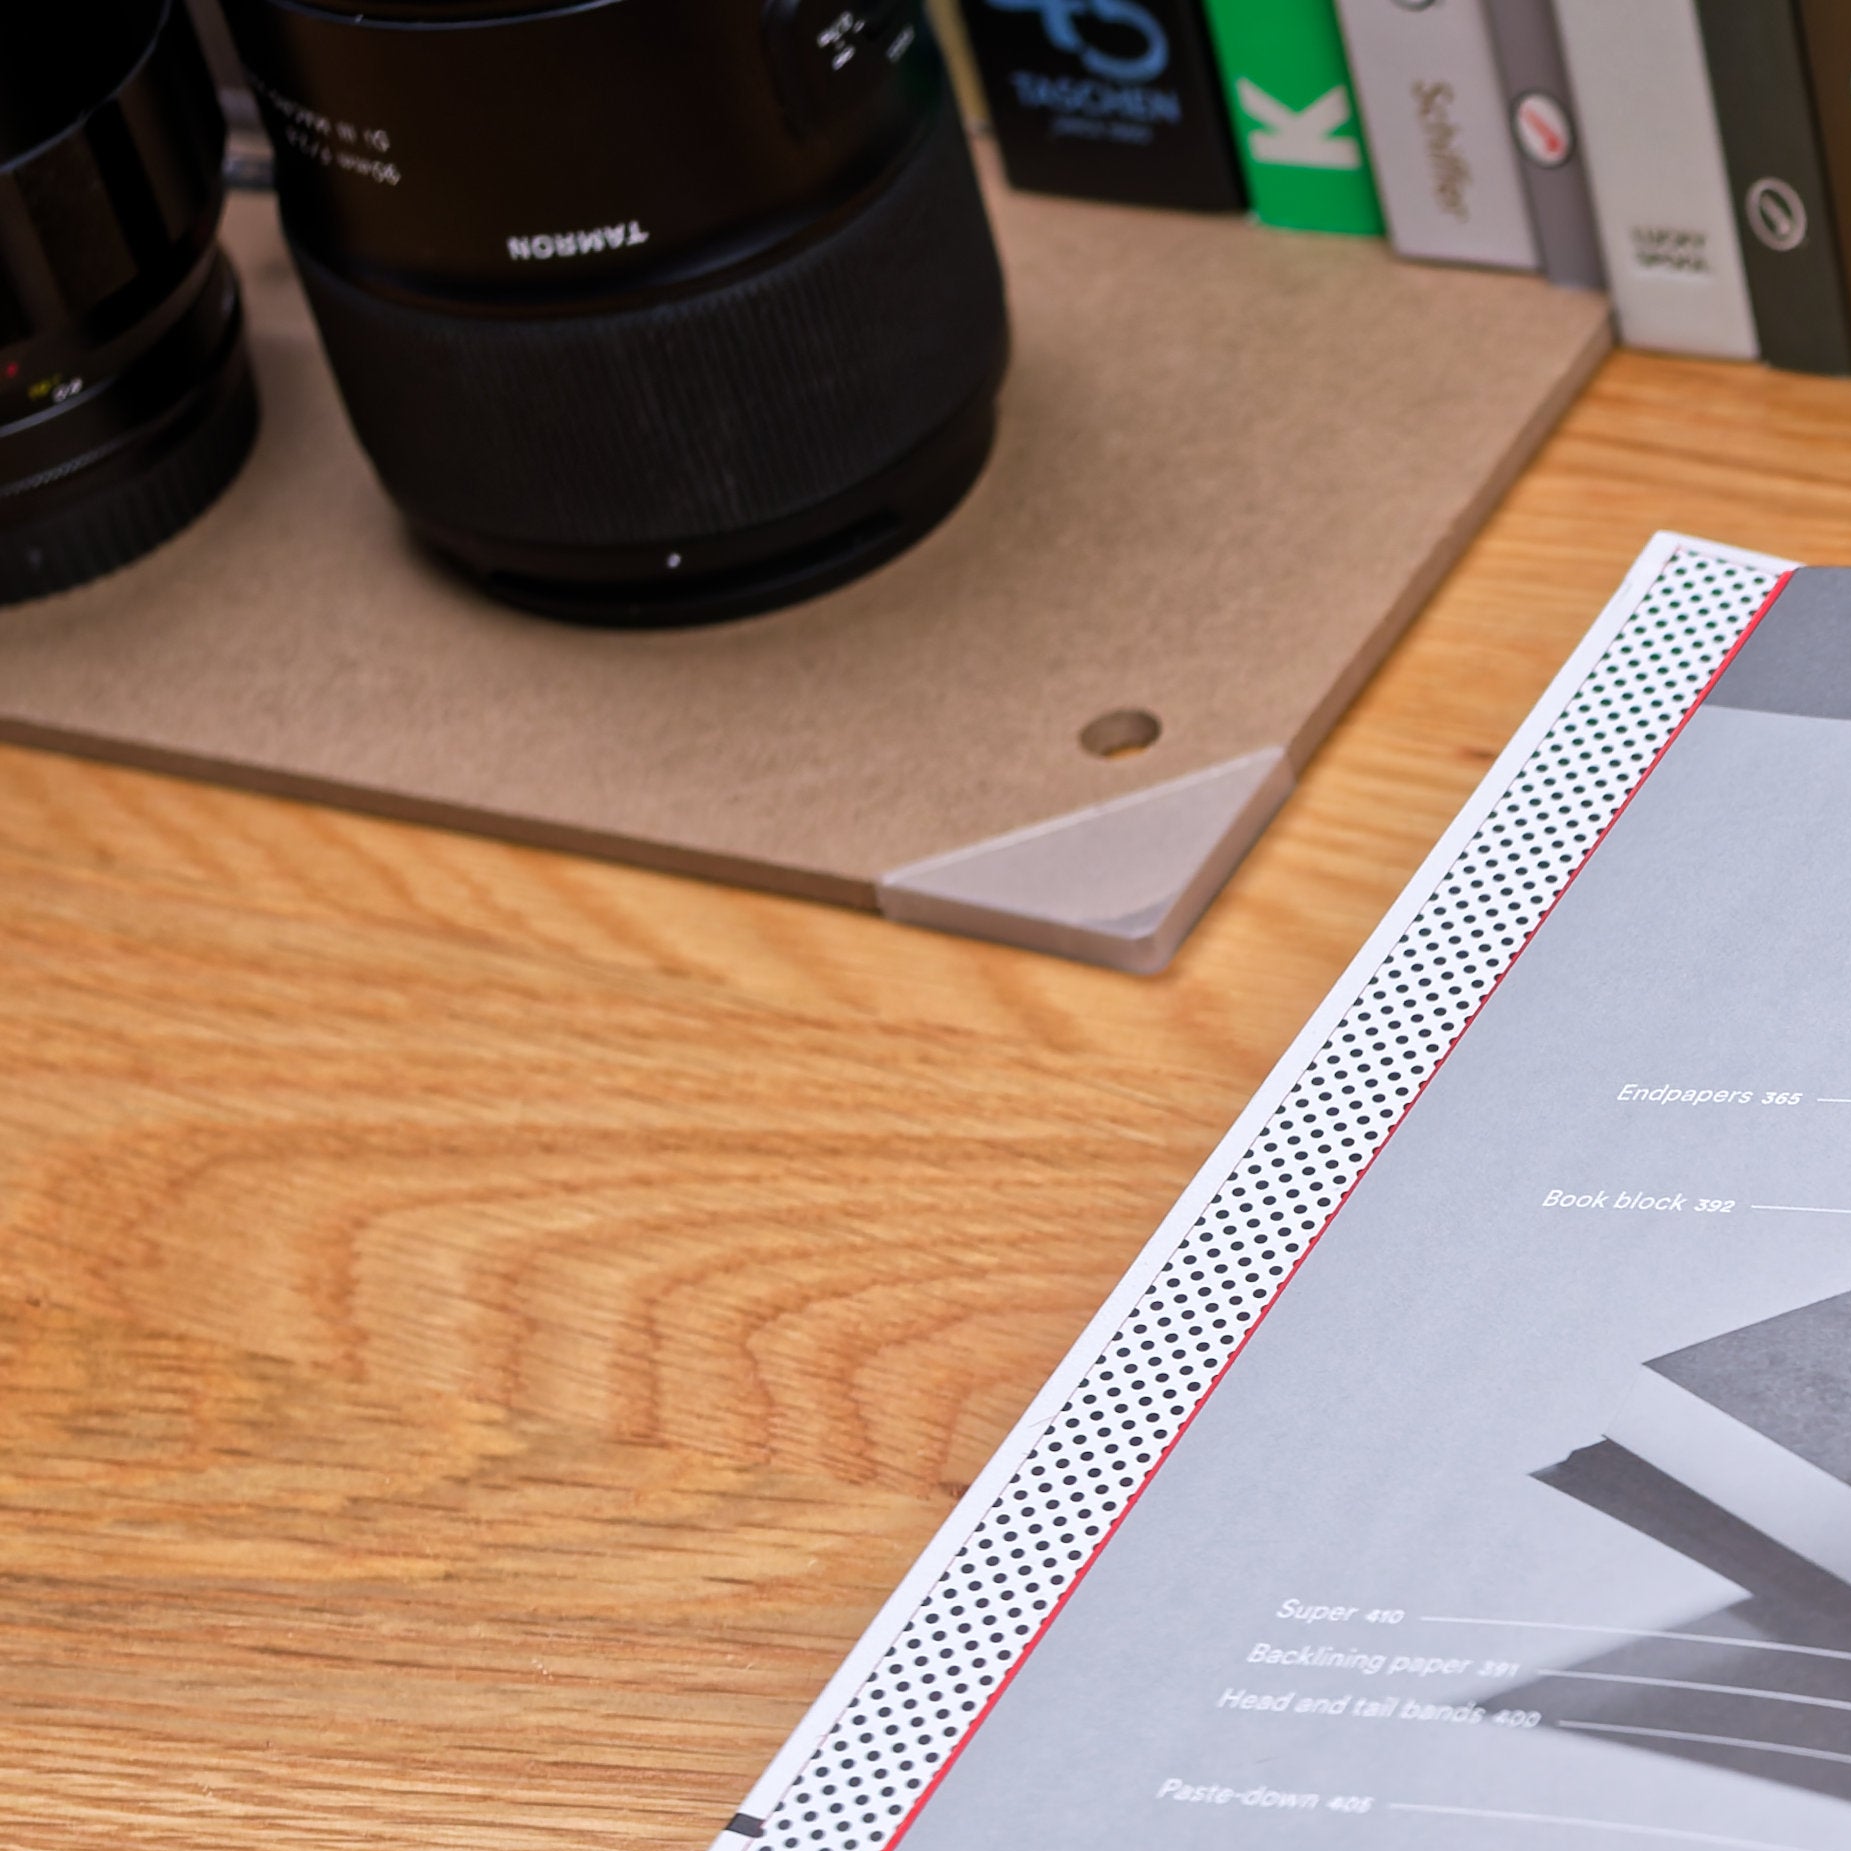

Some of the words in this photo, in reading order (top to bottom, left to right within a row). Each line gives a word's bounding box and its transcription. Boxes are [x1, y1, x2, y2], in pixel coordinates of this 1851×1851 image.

[1235, 75, 1362, 170] K
[508, 221, 649, 262] TAMRON
[1616, 1083, 1753, 1107] Endpapers
[1760, 1091, 1803, 1106] 365
[1541, 1188, 1606, 1210] Book
[1612, 1191, 1687, 1212] block
[1694, 1198, 1736, 1214] 392
[1275, 1598, 1359, 1626] Super
[1364, 1608, 1405, 1625] 410
[1246, 1642, 1386, 1676] Backlining
[1388, 1655, 1473, 1679] paper
[1217, 1687, 1291, 1713] Head
[1294, 1692, 1350, 1716] and
[1351, 1694, 1402, 1718] tail
[1399, 1699, 1483, 1726] bands
[1492, 1710, 1542, 1729] 400
[1156, 1777, 1320, 1810] Paste-down
